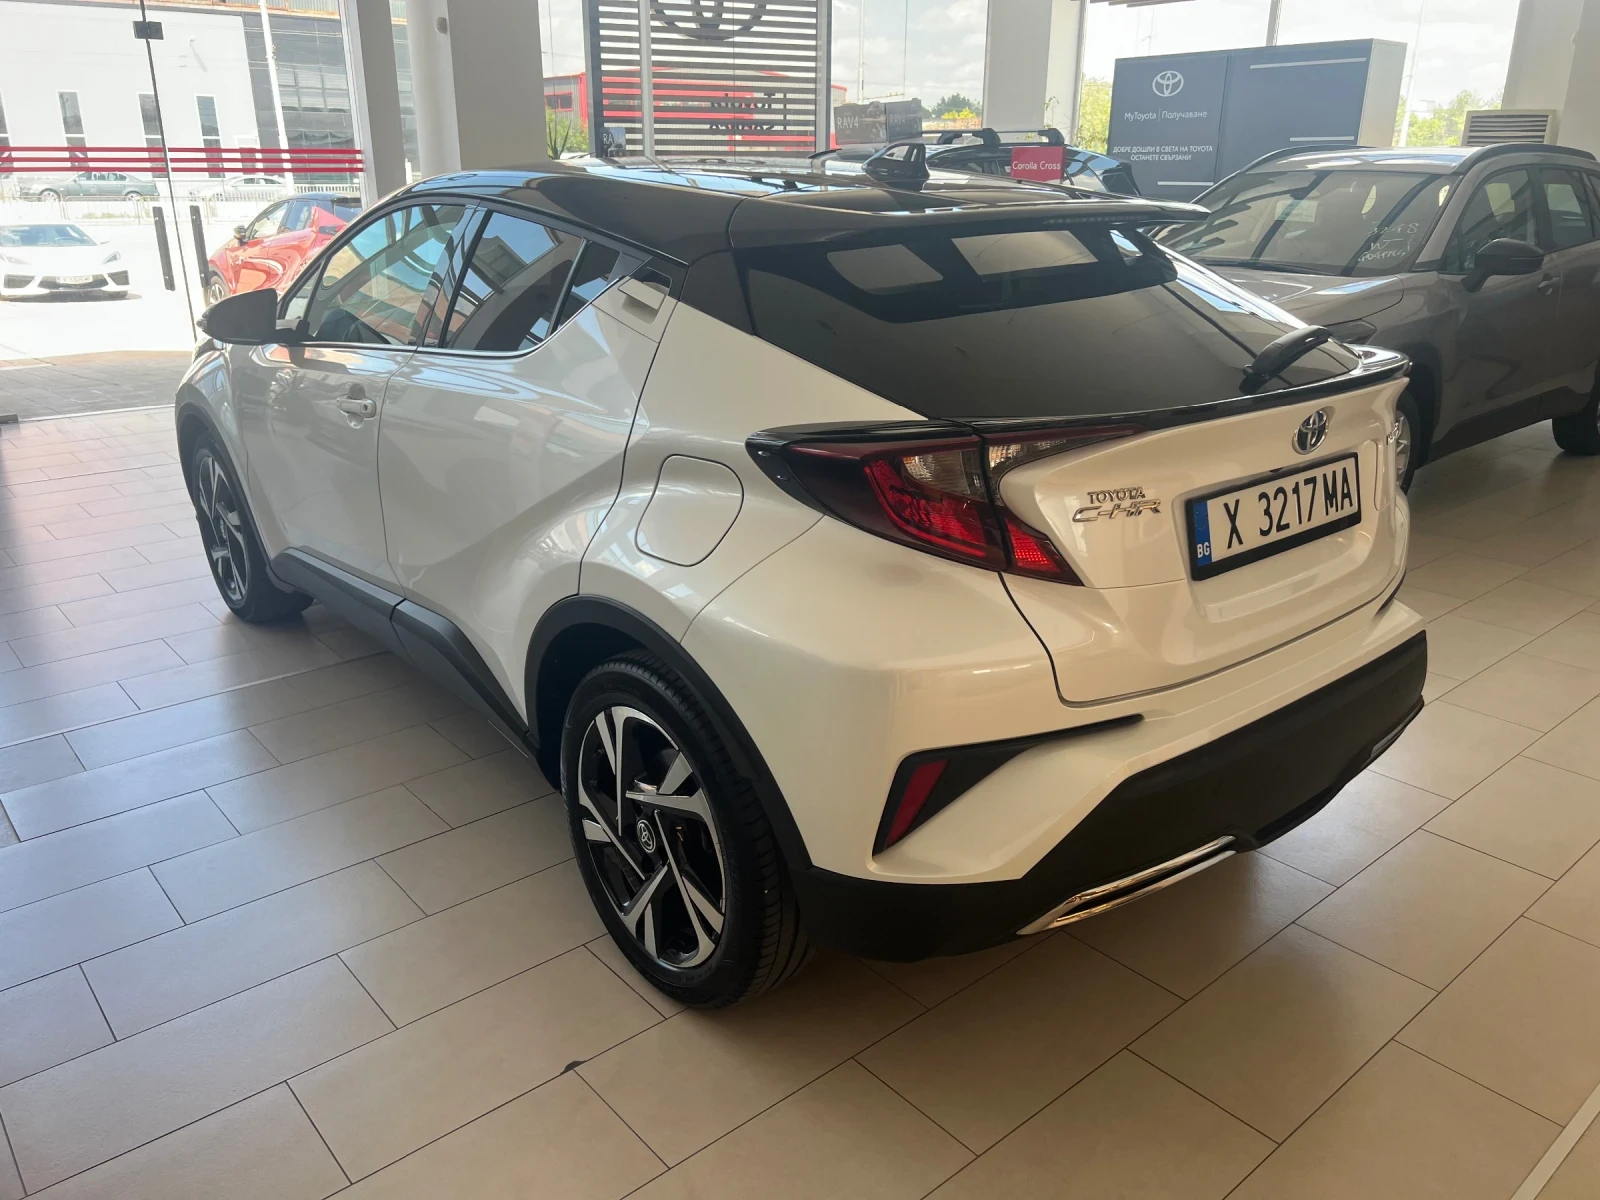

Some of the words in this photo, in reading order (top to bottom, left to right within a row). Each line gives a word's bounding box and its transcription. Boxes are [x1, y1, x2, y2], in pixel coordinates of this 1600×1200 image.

[837, 116, 859, 129] RAV4
[1124, 111, 1156, 121] MyToyota
[1161, 110, 1207, 120] Получаване
[1012, 161, 1038, 170] Corolla
[1040, 161, 1061, 170] Cross
[1087, 487, 1146, 504] TOYOTA
[1072, 499, 1161, 522] C-HR
[1223, 499, 1243, 550] X
[1258, 476, 1317, 537] 3217
[1322, 467, 1353, 516] MA
[1197, 542, 1210, 558] BG
